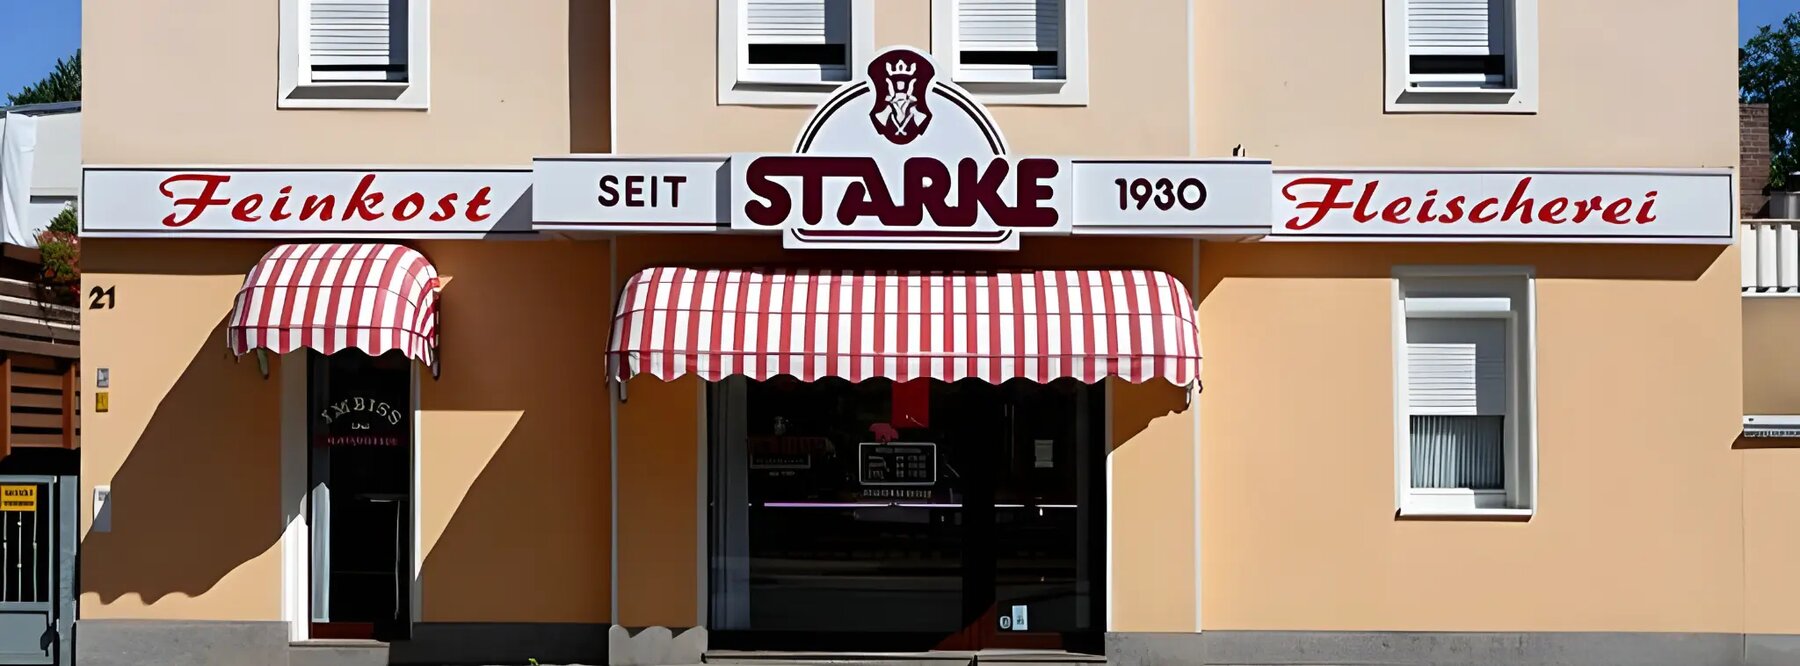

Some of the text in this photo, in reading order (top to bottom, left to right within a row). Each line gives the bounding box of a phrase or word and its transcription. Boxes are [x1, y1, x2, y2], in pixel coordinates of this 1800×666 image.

[159, 174, 491, 227] Feinkost
[598, 174, 687, 208] SEIT
[745, 156, 1059, 227] STARKE
[1115, 177, 1207, 212] 1930
[1282, 177, 1658, 230] Fleischerei
[89, 285, 115, 310] 21
